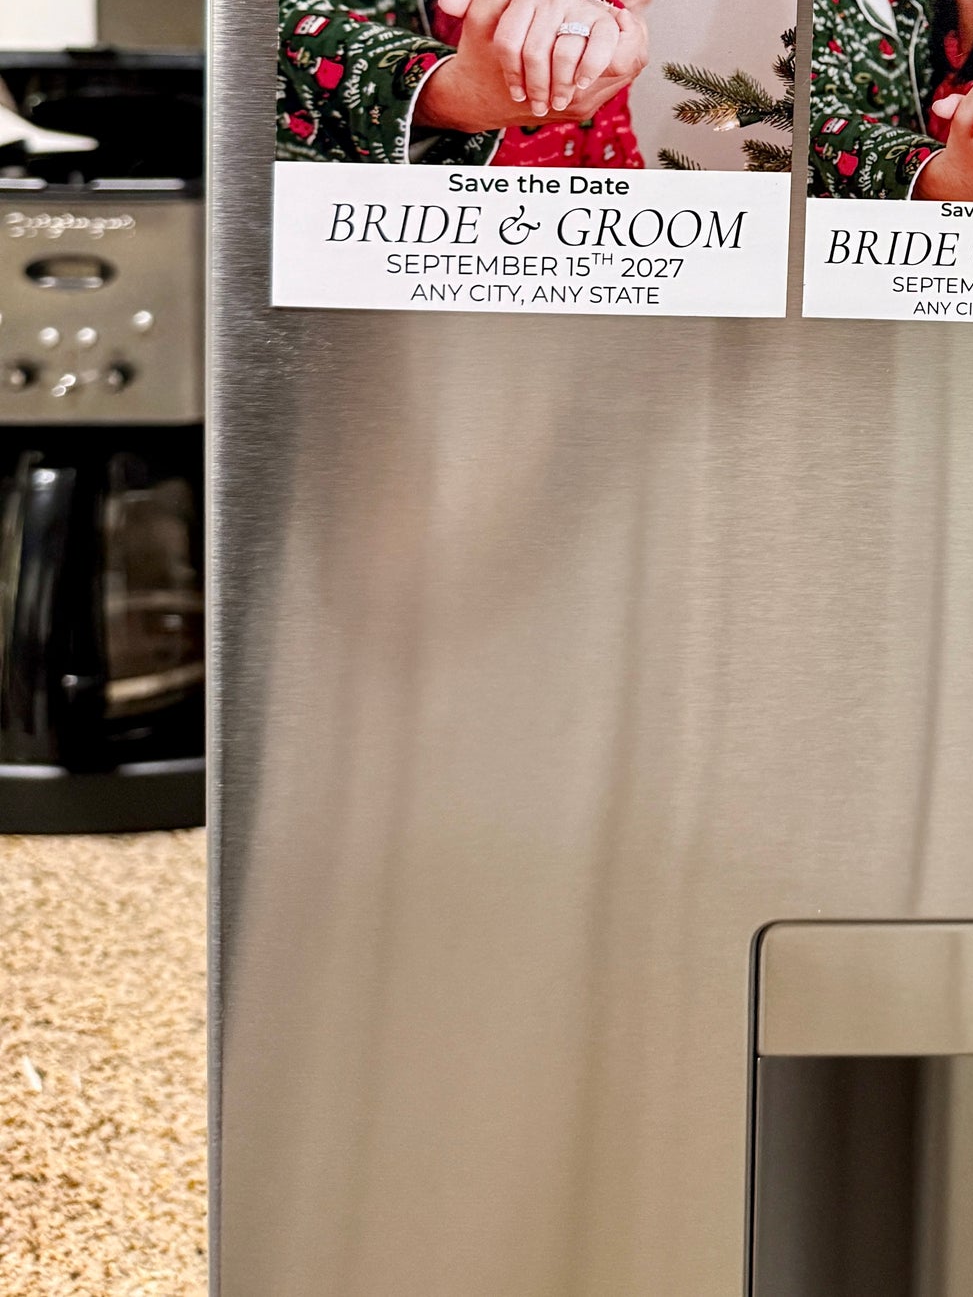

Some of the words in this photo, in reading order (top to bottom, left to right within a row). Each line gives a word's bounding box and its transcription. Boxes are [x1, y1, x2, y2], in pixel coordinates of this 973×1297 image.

[448, 173, 510, 193] Save
[516, 173, 561, 194] the
[569, 175, 630, 196] Date
[325, 203, 482, 244] BRIDE
[498, 204, 541, 246] &
[556, 207, 749, 249] GROOM
[823, 229, 960, 267] BRIDE
[386, 253, 558, 277] SEPTEMBER
[565, 252, 613, 277] 15TH
[620, 257, 684, 279] 2027
[410, 283, 463, 302] ANY
[469, 284, 525, 306] CITY,
[531, 285, 584, 303] ANY
[589, 285, 660, 305] STATE
[912, 301, 952, 315] ANY
